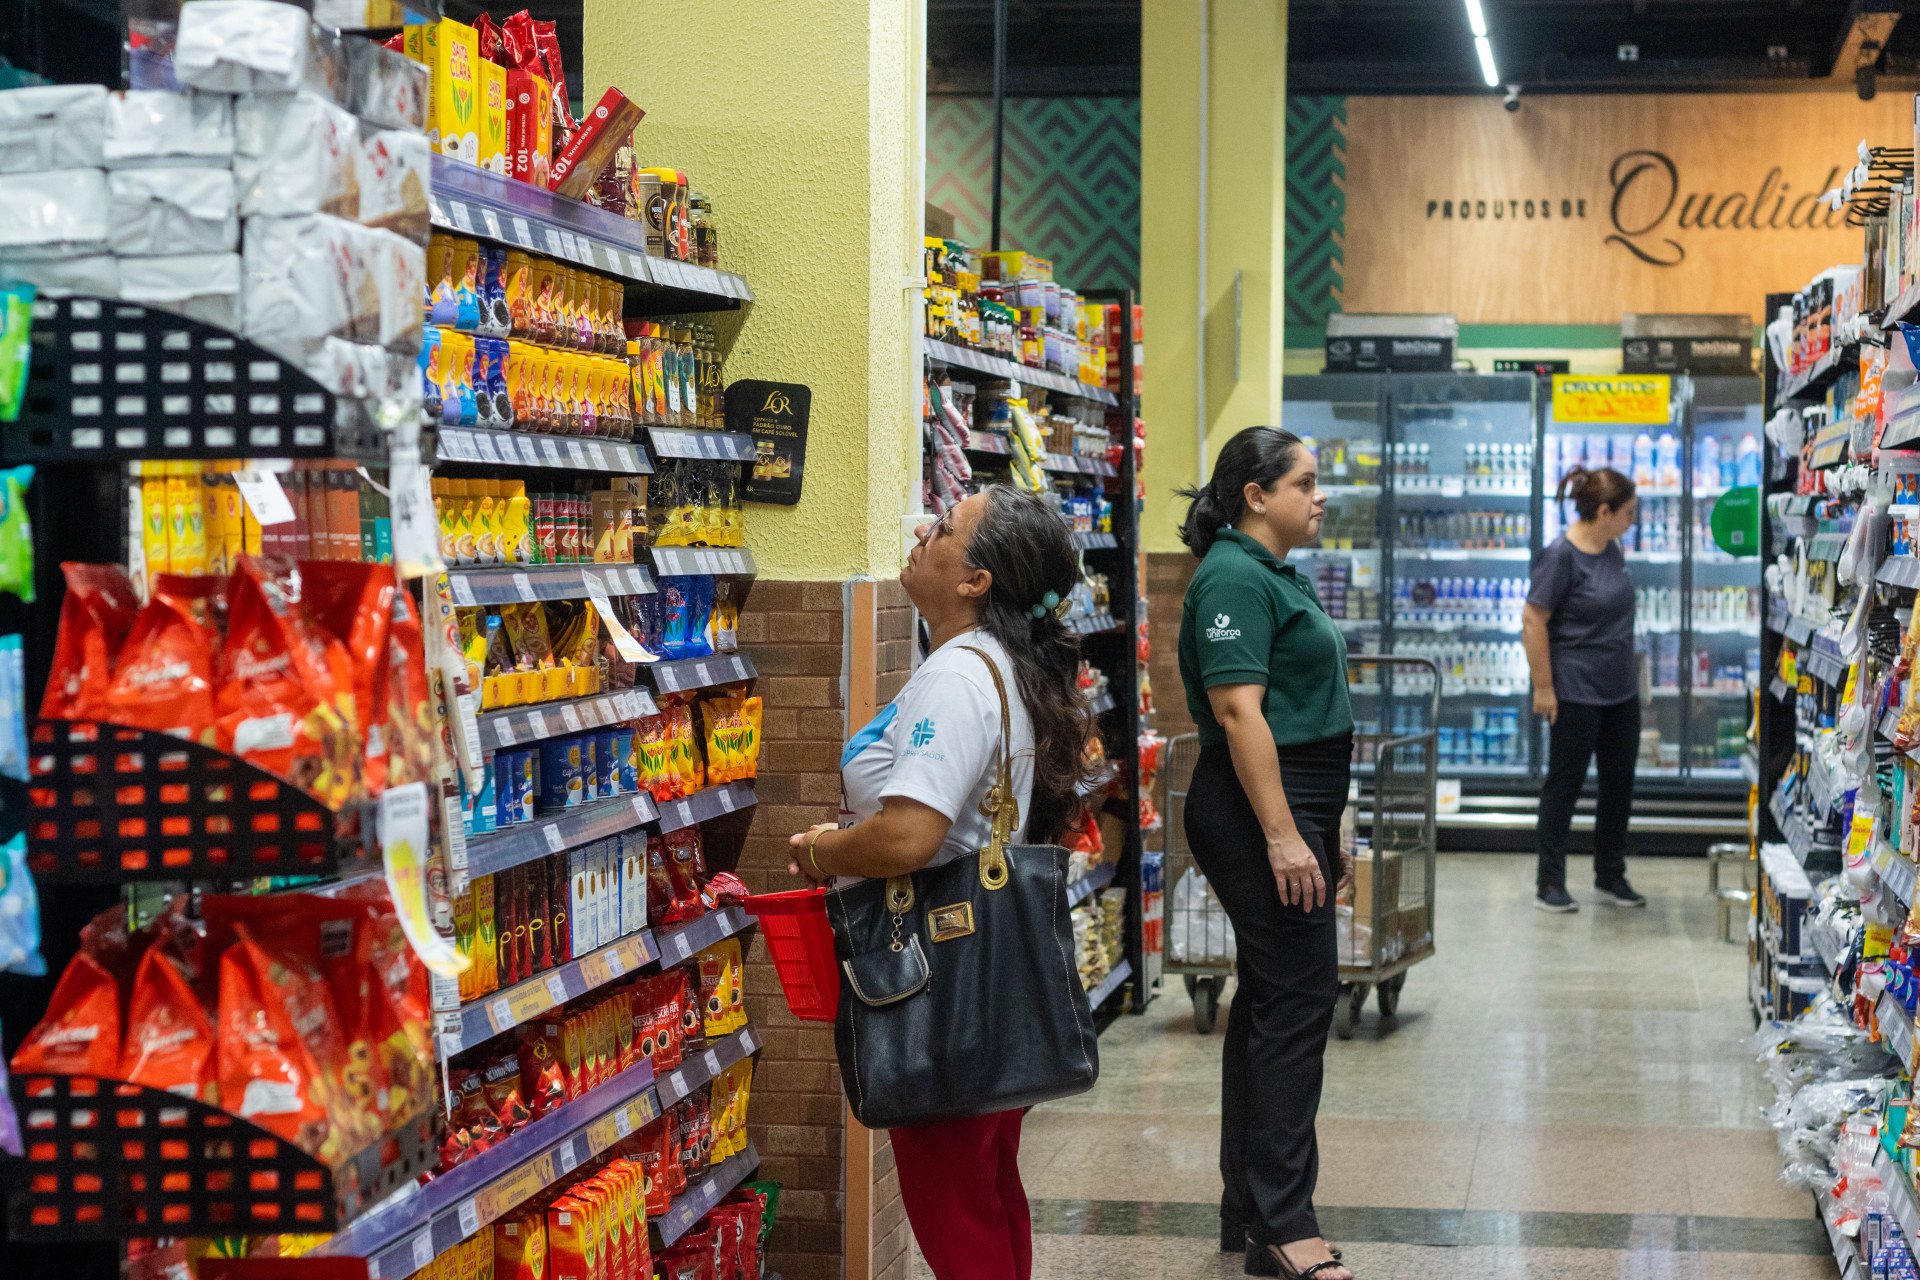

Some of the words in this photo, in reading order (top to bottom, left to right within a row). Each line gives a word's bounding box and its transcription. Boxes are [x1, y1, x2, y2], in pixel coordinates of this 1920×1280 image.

[517, 148, 529, 173] 102
[550, 156, 573, 182] 103
[1426, 199, 1551, 220] PRODUTOS
[1561, 199, 1588, 219] DE
